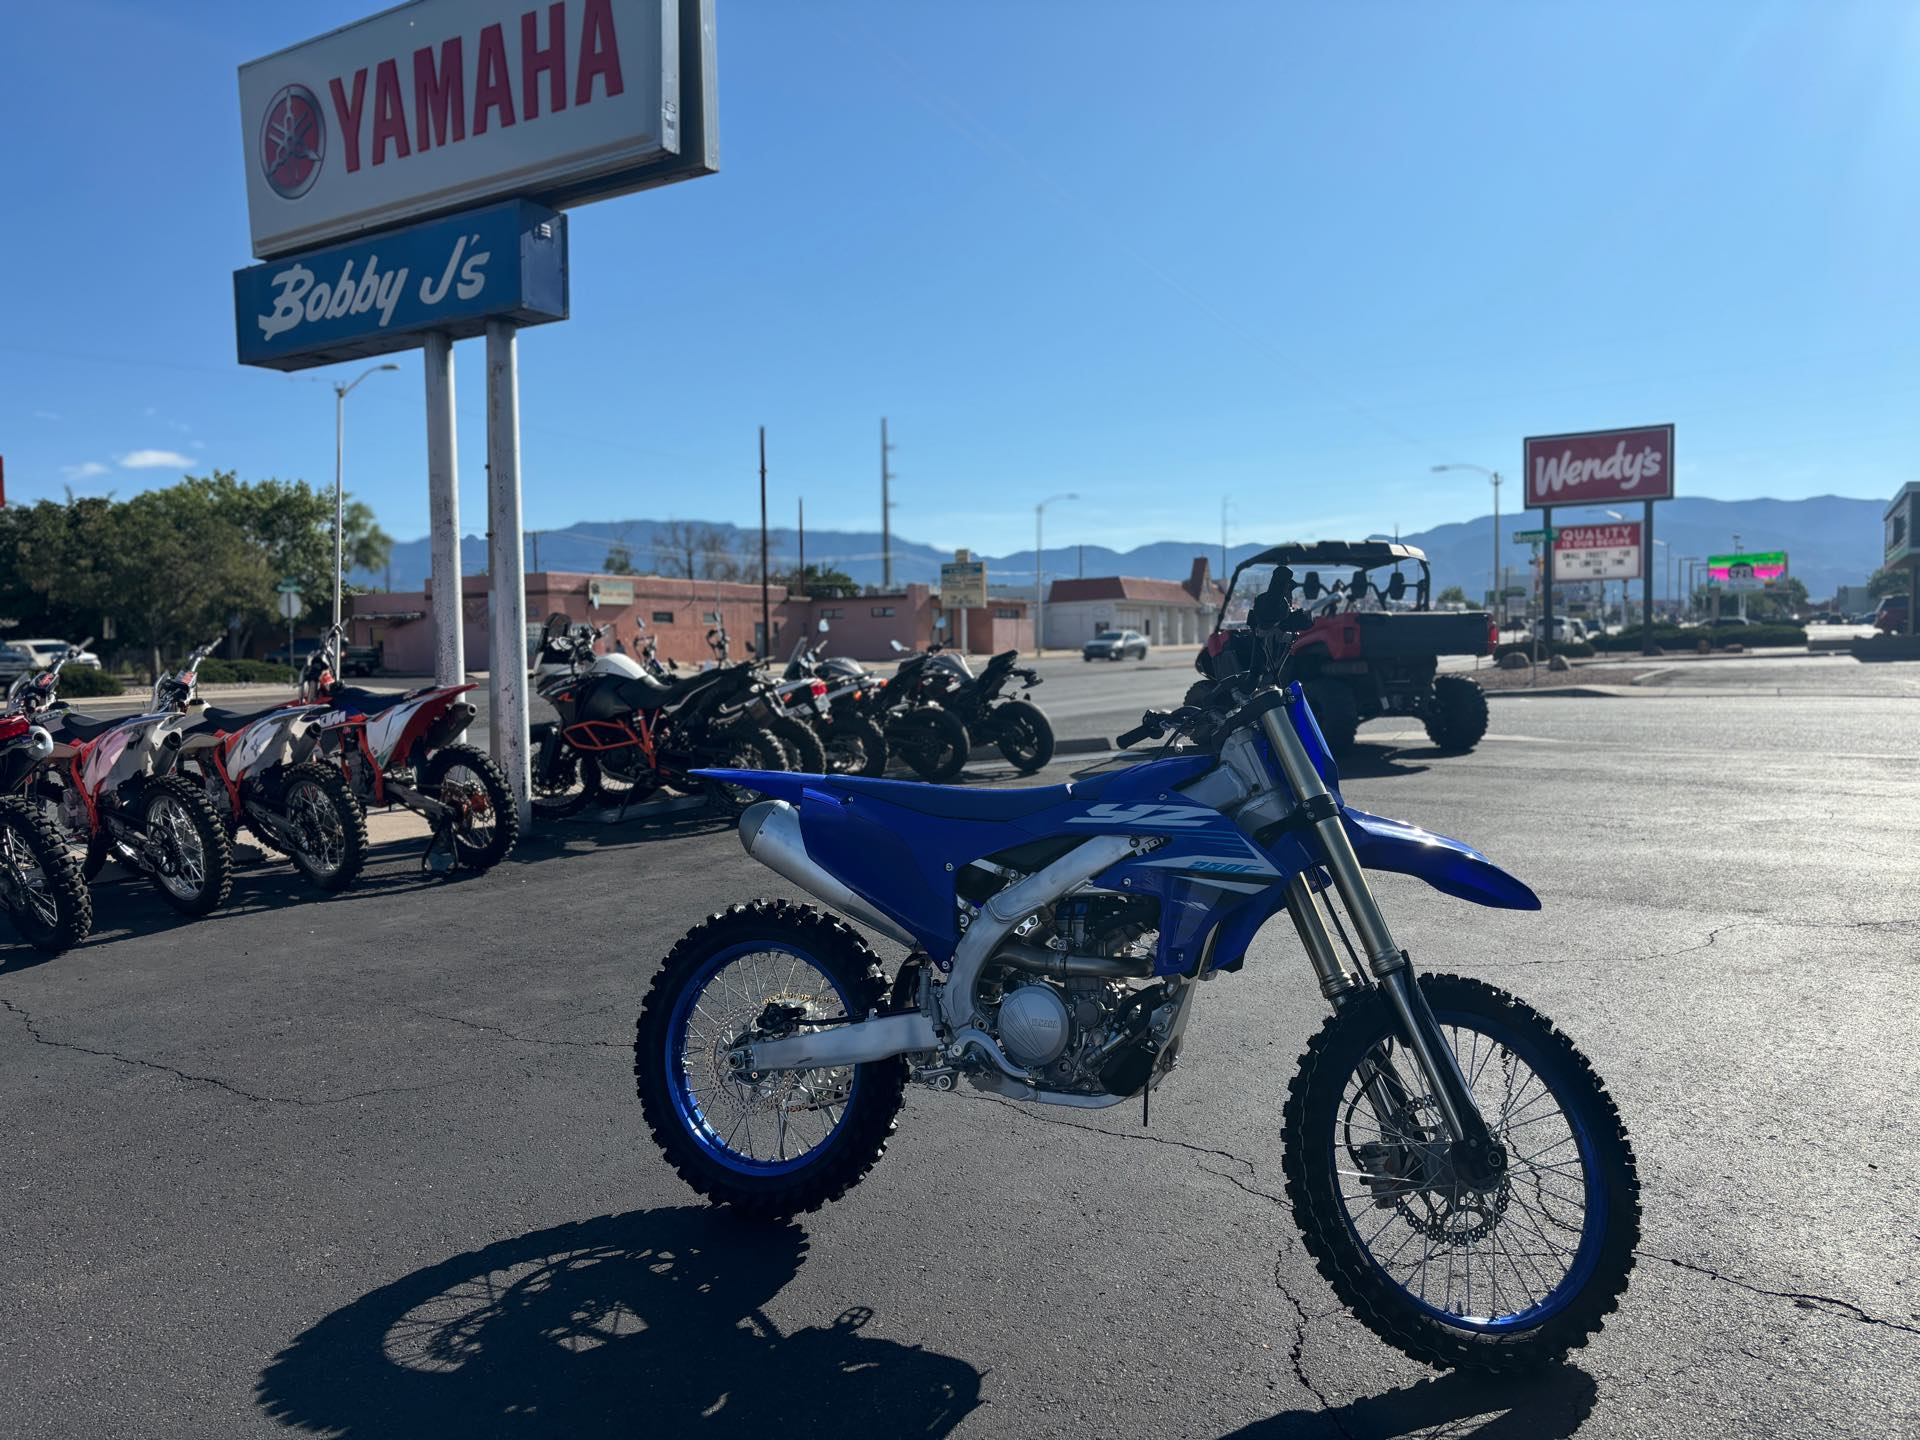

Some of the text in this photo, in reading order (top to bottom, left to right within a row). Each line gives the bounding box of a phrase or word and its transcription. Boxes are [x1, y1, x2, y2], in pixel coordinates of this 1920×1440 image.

[329, 0, 625, 174] YAMAHA
[258, 233, 491, 341] Bobby J's
[1535, 441, 1662, 497] Wendy's
[1562, 526, 1631, 541] QUALITY
[320, 709, 346, 728] KTM
[1064, 803, 1222, 826] YZ
